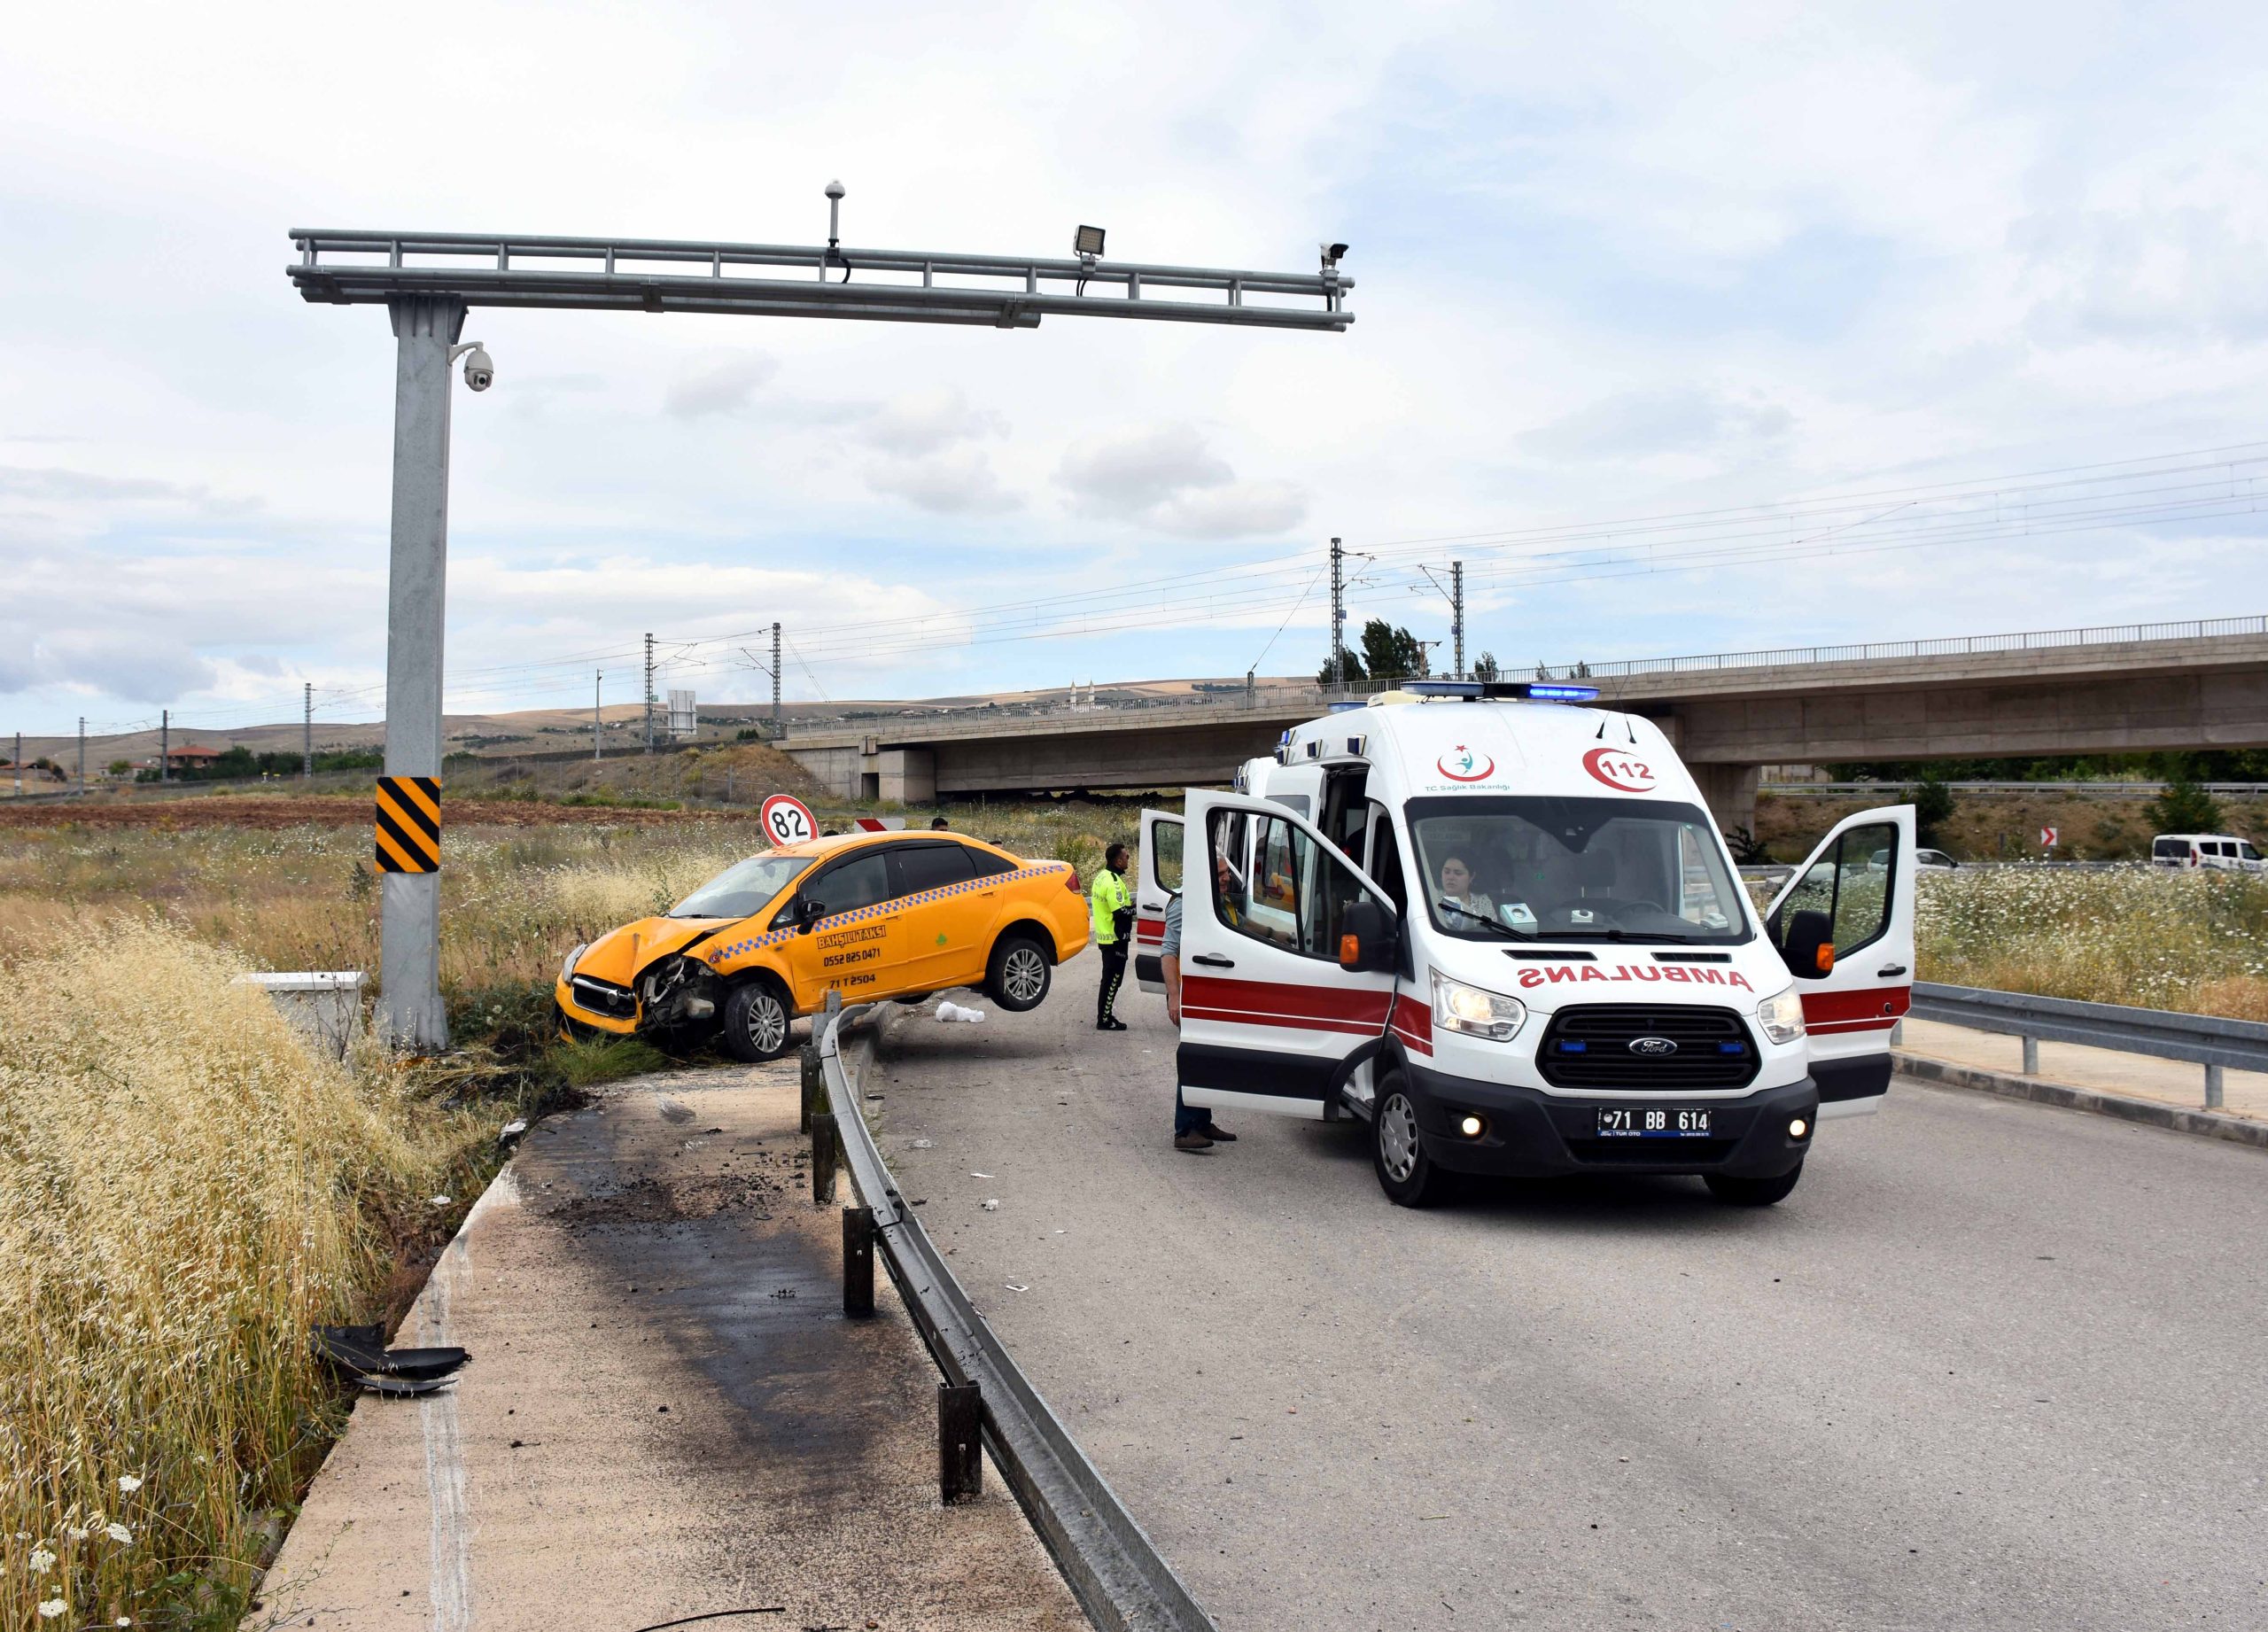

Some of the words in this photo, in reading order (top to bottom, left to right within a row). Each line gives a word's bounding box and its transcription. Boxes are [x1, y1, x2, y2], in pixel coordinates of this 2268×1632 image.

[1602, 761, 1655, 780] 112
[772, 810, 808, 838] 82
[824, 954, 844, 967] 0552
[846, 951, 861, 963] 825
[862, 948, 881, 960] 0471
[830, 980, 840, 989] 71
[843, 978, 849, 987] T
[850, 974, 876, 986] 2504
[1612, 1111, 1631, 1130] 71
[1645, 1111, 1666, 1130] BB
[1678, 1111, 1708, 1131] 614
